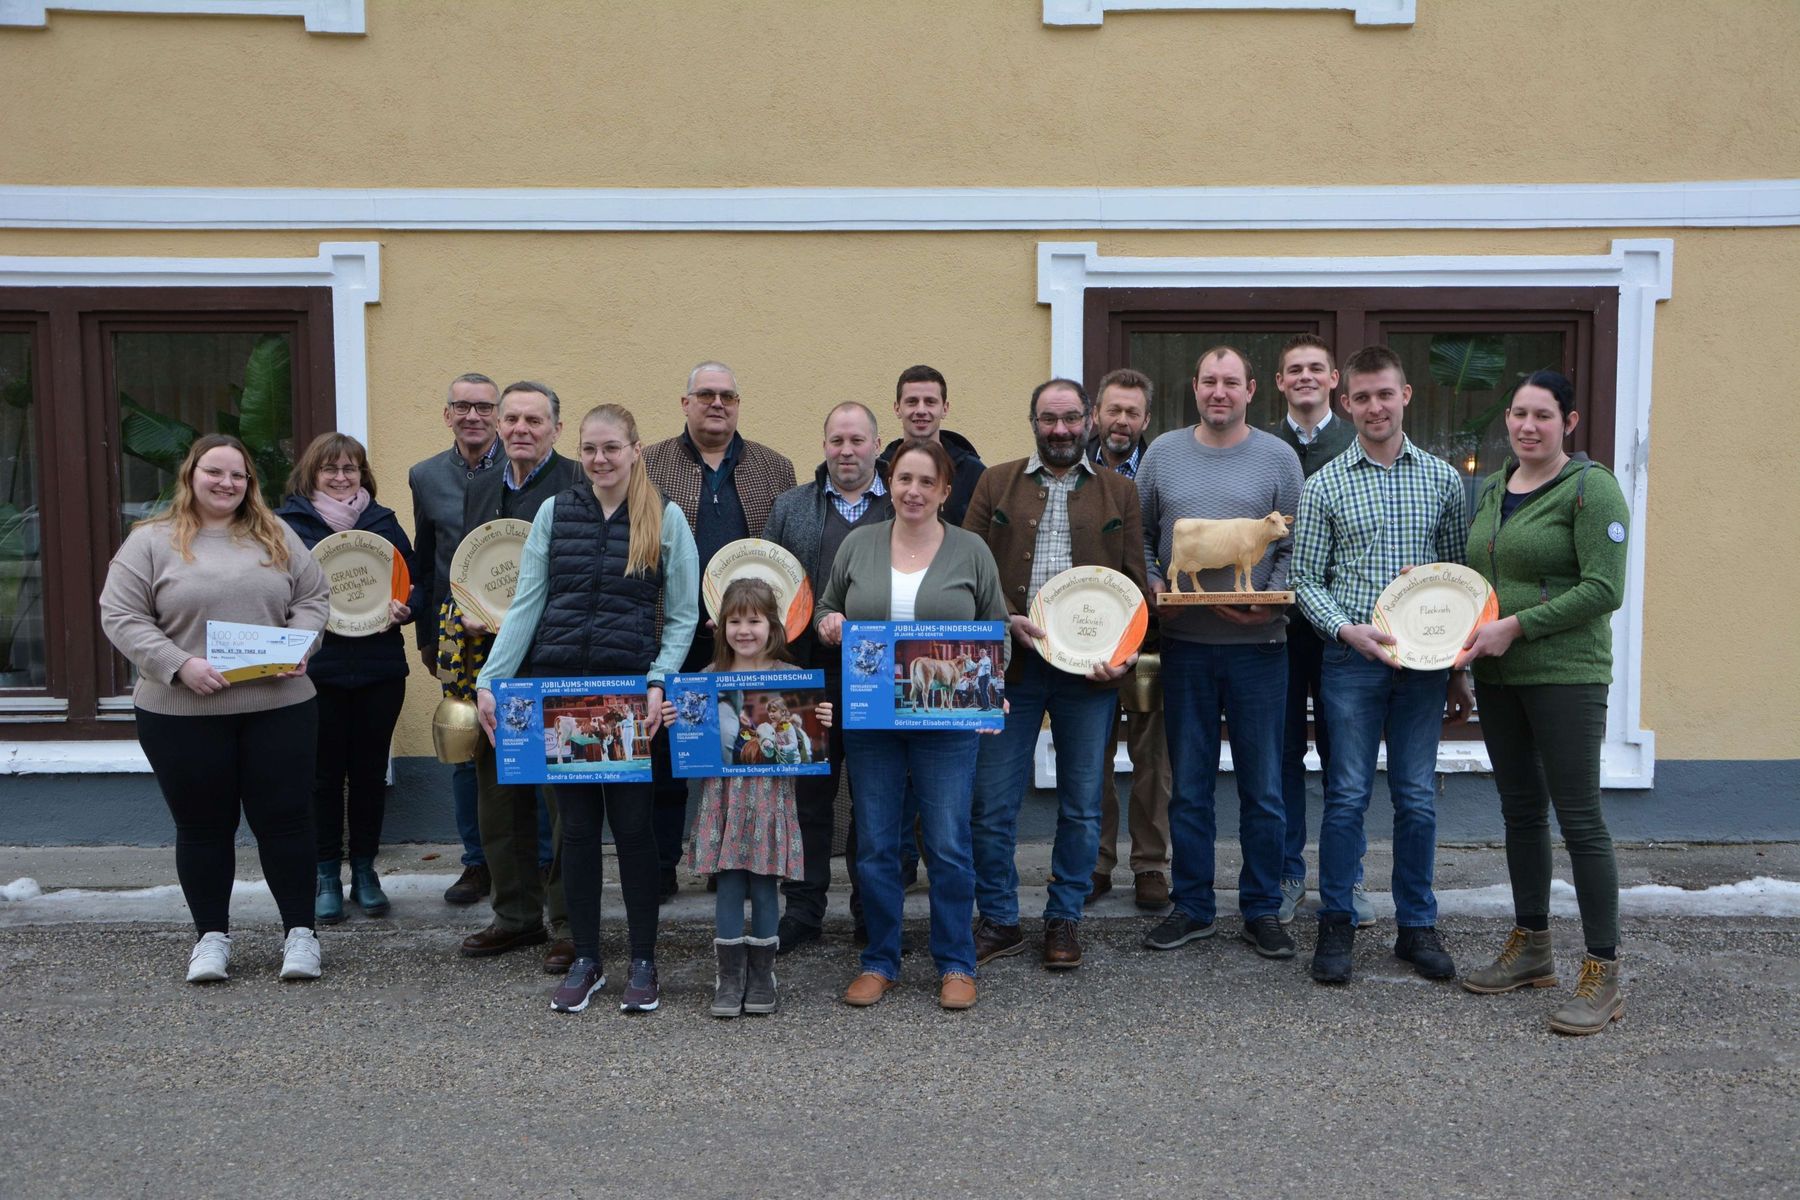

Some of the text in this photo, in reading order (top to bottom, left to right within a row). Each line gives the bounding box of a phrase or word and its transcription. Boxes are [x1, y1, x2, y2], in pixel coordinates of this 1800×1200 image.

[506, 522, 528, 539] Ötsche
[331, 566, 368, 582] GERALDIN
[347, 590, 365, 602] 2025
[894, 624, 993, 632] JUBILÄUMS-RINDERSCHAU
[1077, 627, 1097, 637] 2025
[1422, 625, 1446, 636] 2025
[715, 673, 813, 683] JUBILÄUMS-RINDERSCHAU
[541, 679, 636, 689] JUBILÄUMS-RINDERSCHAU
